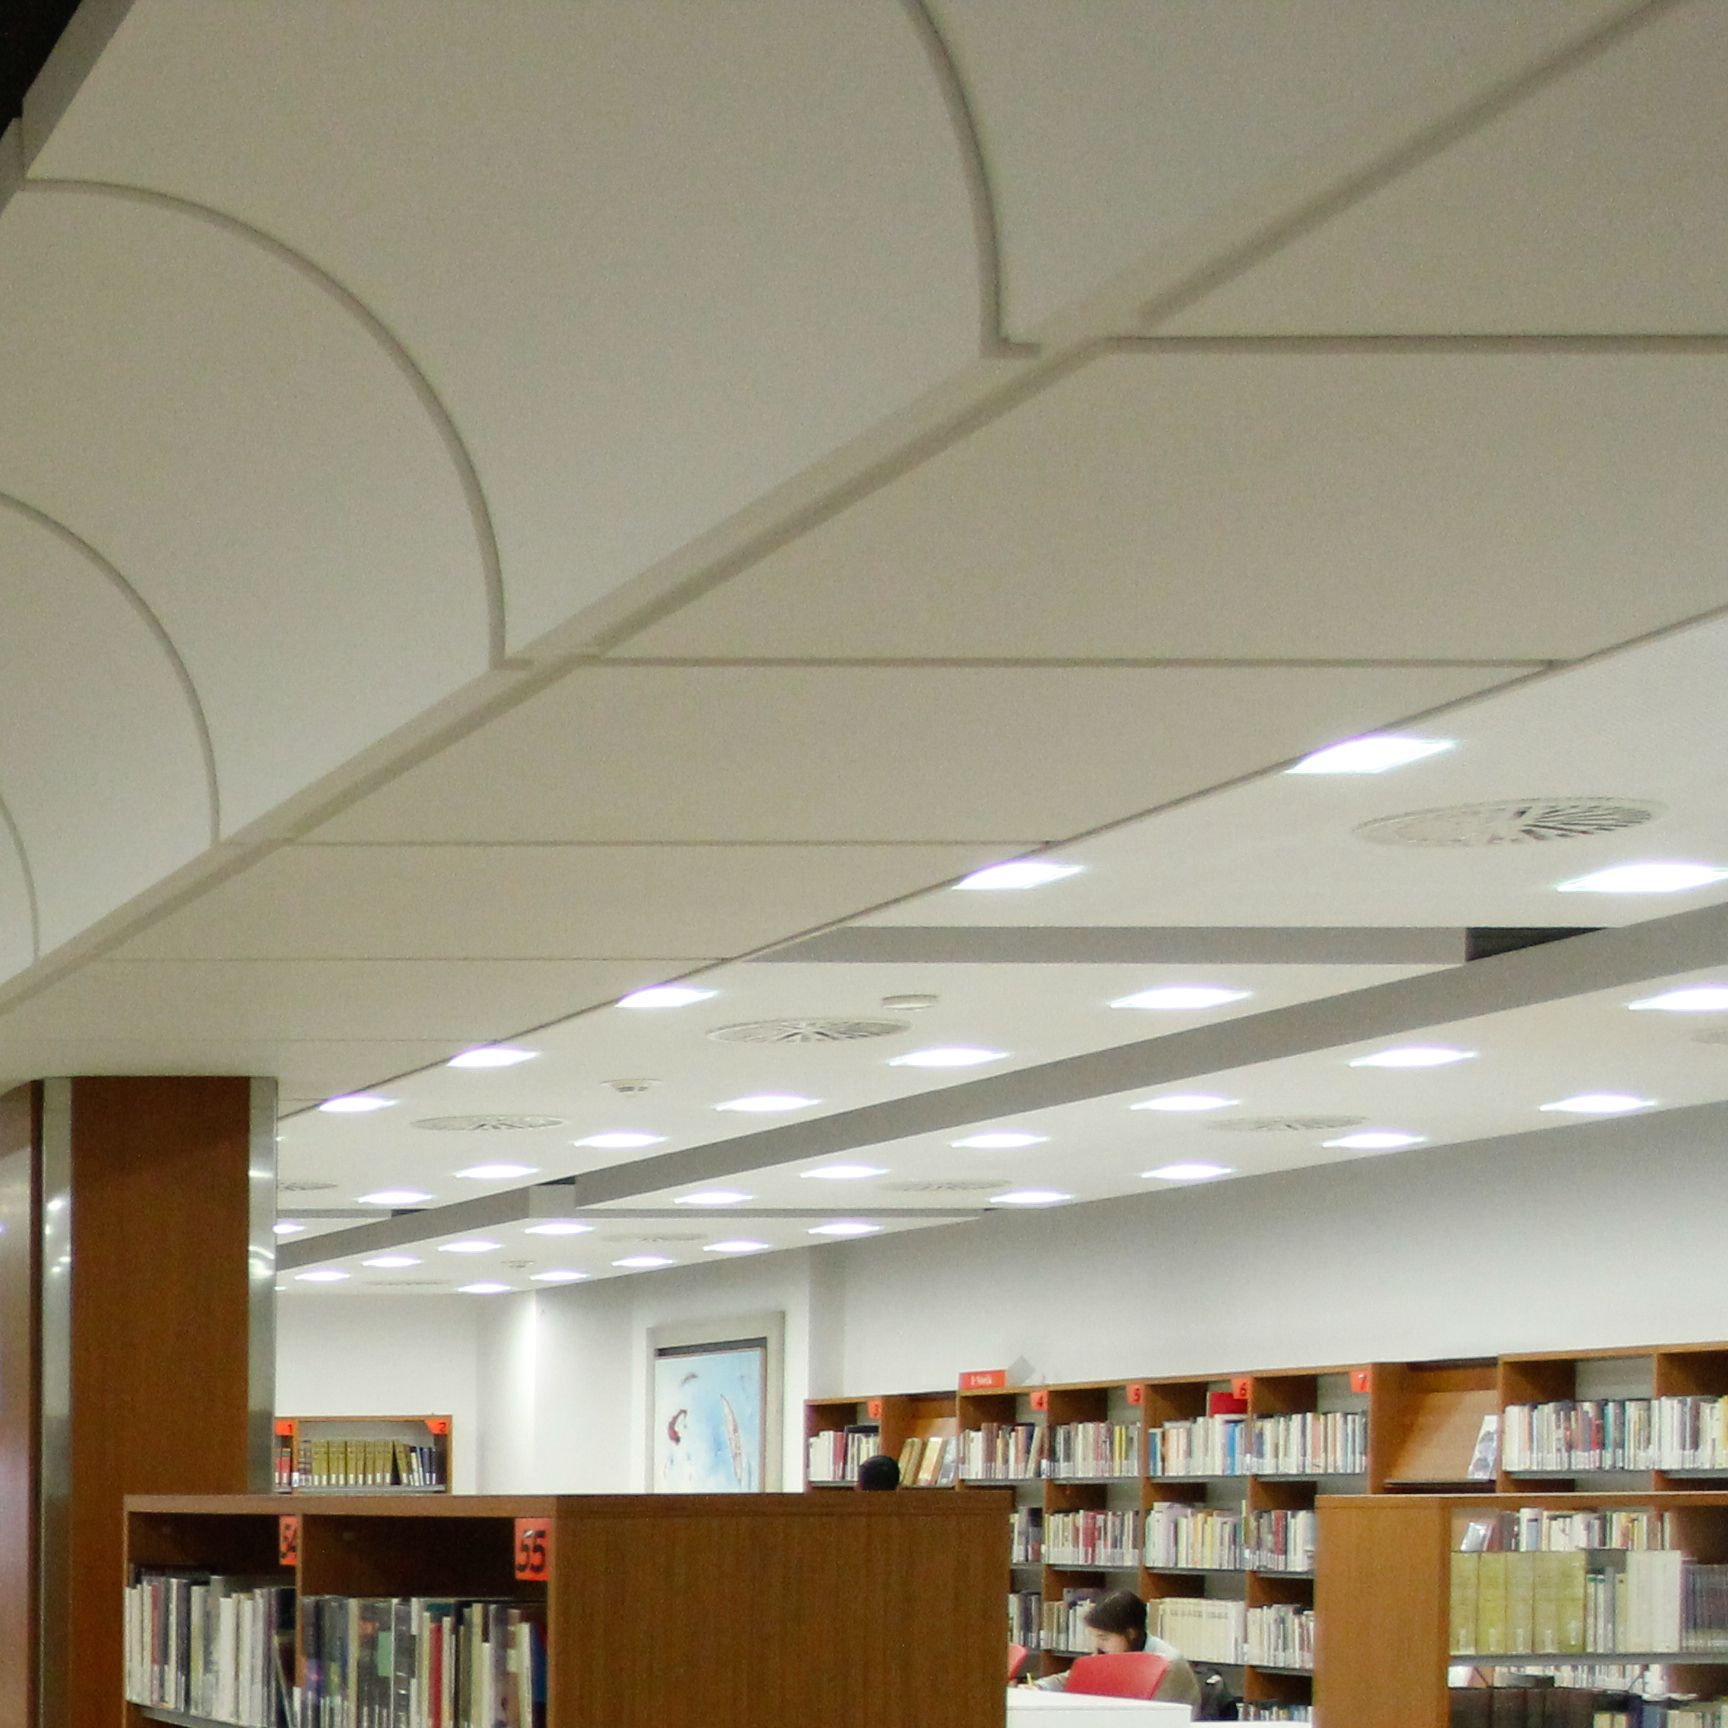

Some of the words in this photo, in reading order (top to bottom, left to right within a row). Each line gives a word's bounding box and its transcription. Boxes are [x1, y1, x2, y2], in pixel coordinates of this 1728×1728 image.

[1358, 1373, 1367, 1390] 7
[1132, 1388, 1141, 1403] 5
[1239, 1382, 1248, 1398] 6
[1035, 1395, 1044, 1408] 4
[438, 1422, 447, 1433] 2
[515, 1529, 546, 1573] 55
